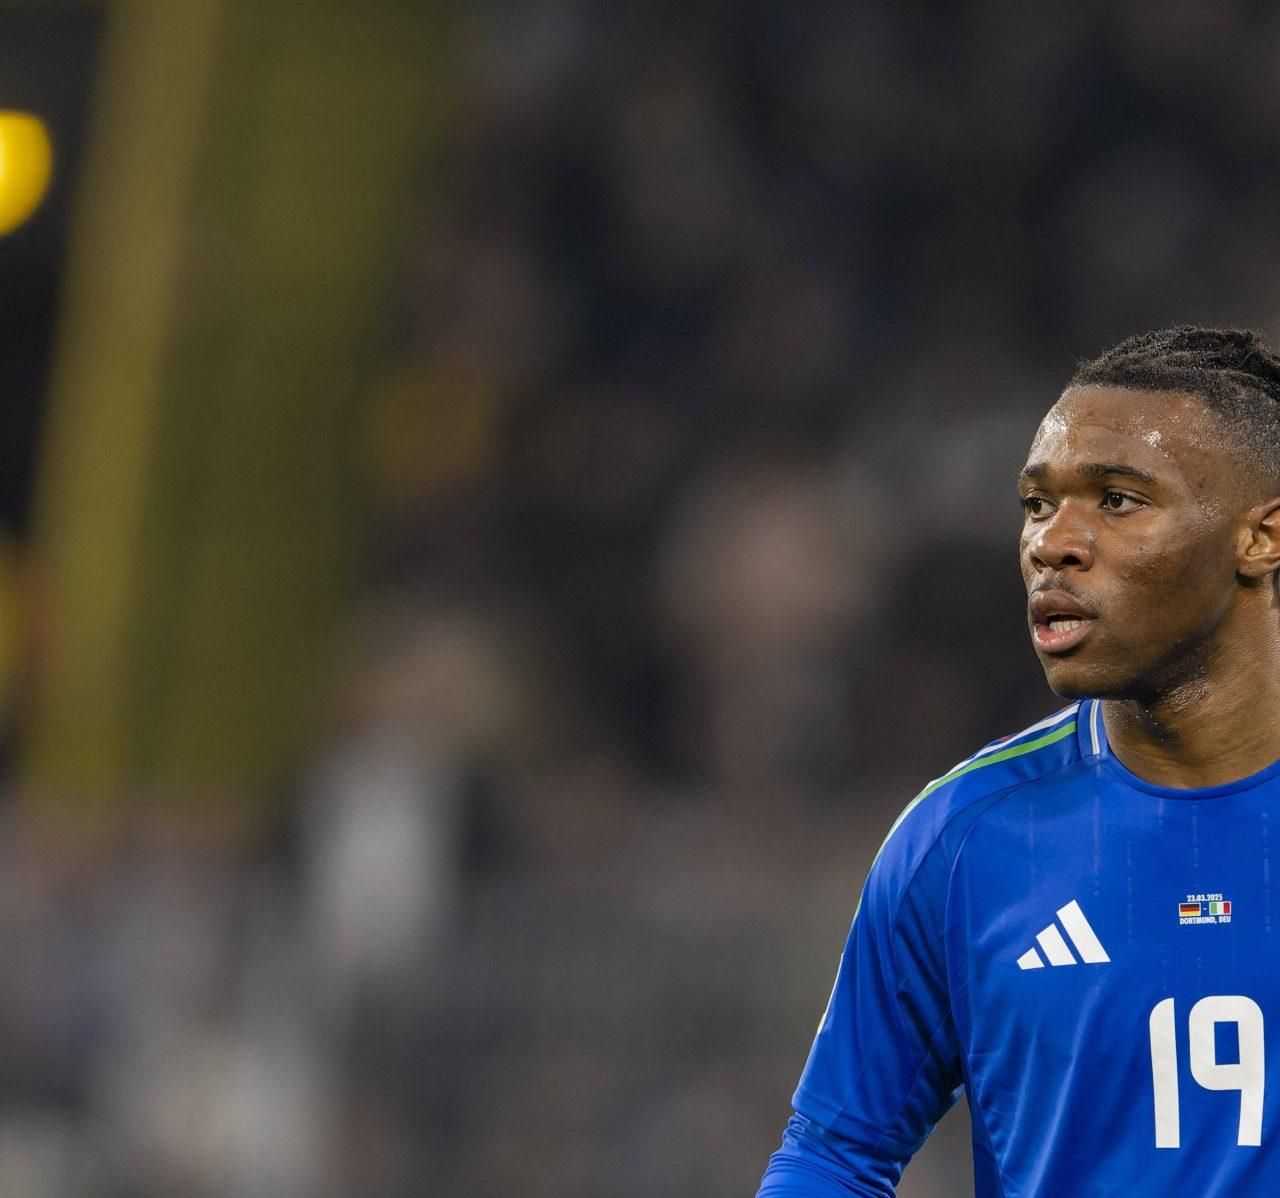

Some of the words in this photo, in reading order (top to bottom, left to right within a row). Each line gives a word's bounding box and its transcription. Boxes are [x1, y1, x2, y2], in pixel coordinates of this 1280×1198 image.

[1186, 894, 1223, 902] 23.03.2025
[1179, 916, 1217, 925] DORTMUND,
[1218, 915, 1231, 923] DEU
[1149, 995, 1264, 1148] 19
